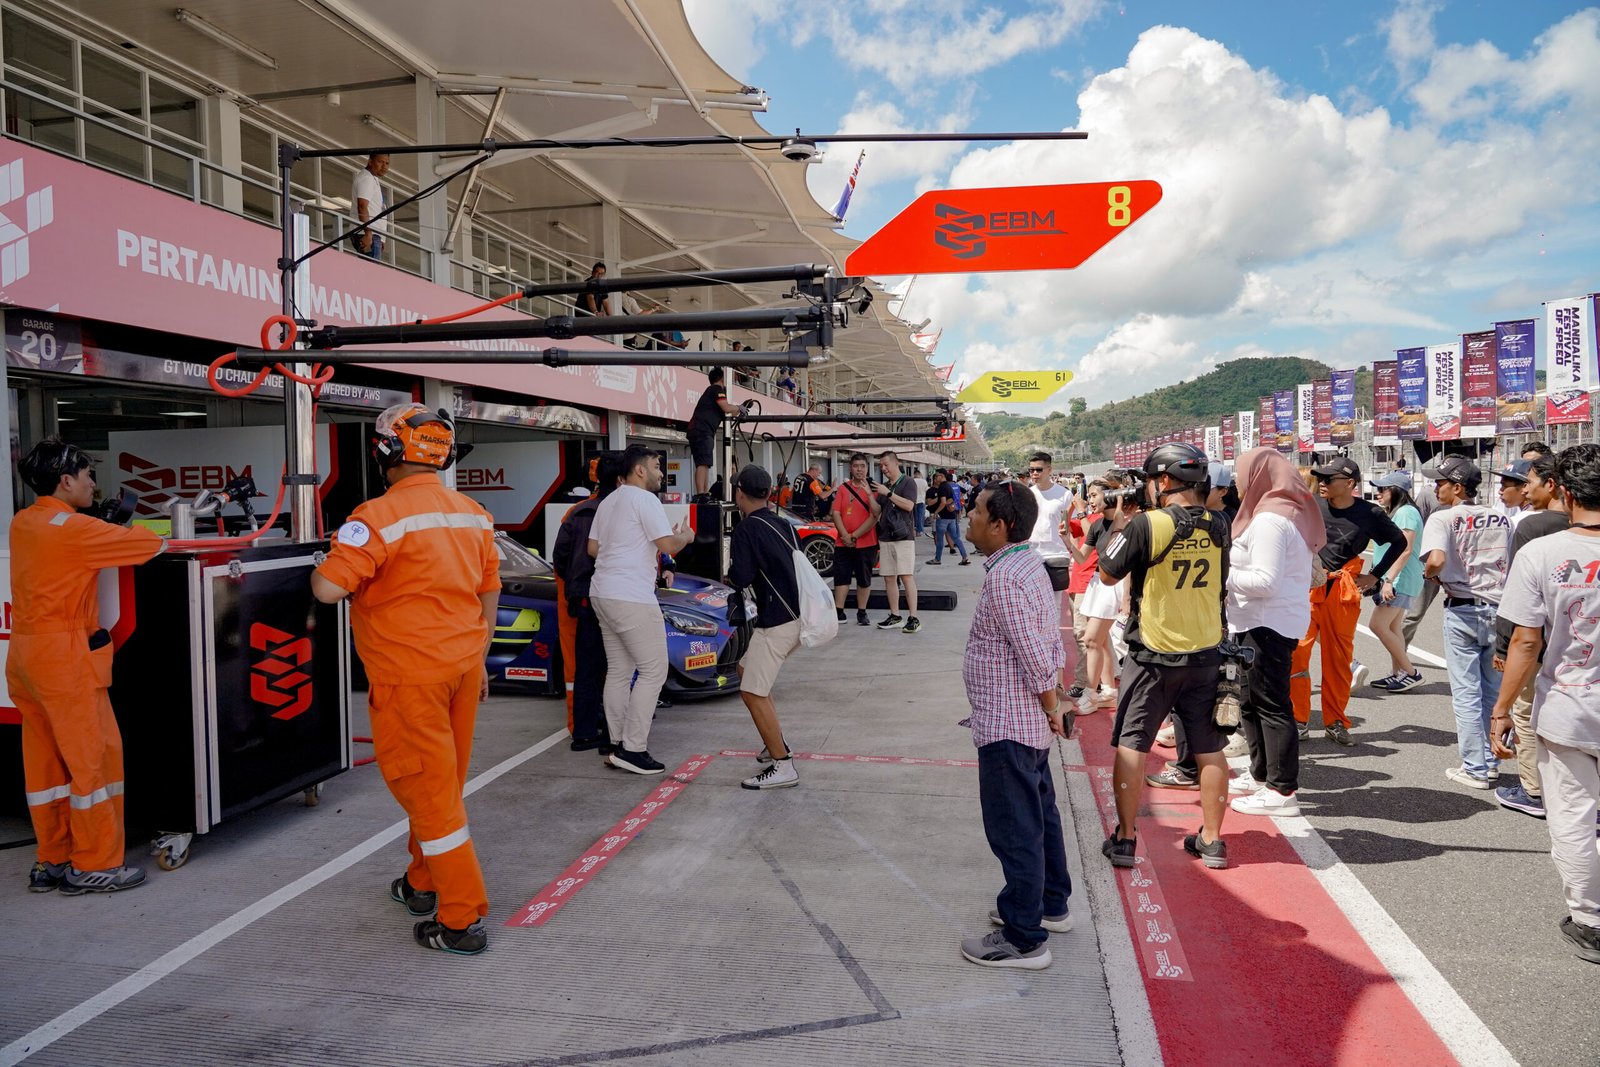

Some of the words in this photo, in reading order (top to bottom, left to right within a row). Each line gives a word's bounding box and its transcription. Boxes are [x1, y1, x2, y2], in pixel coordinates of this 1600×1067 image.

[1108, 186, 1131, 227] 8
[990, 210, 1055, 231] EBM
[117, 229, 283, 305] PERTAMIN
[310, 283, 429, 325] MANDALIK
[22, 318, 54, 331] GARAGE
[1556, 309, 1563, 327] OF
[21, 330, 57, 361] 20
[1556, 328, 1564, 366] SPEED
[1563, 308, 1571, 367] FESTIVAL
[1572, 307, 1580, 383] MANDALIKA
[164, 360, 180, 374] GT
[183, 361, 223, 380] WORD
[352, 387, 363, 398] BY
[364, 389, 381, 400] AWS
[1012, 380, 1037, 388] EBM
[1055, 372, 1066, 382] 61
[794, 479, 805, 494] 51
[1172, 537, 1211, 550] SRO
[1171, 558, 1211, 590] 72
[688, 656, 715, 668] PIRELLI
